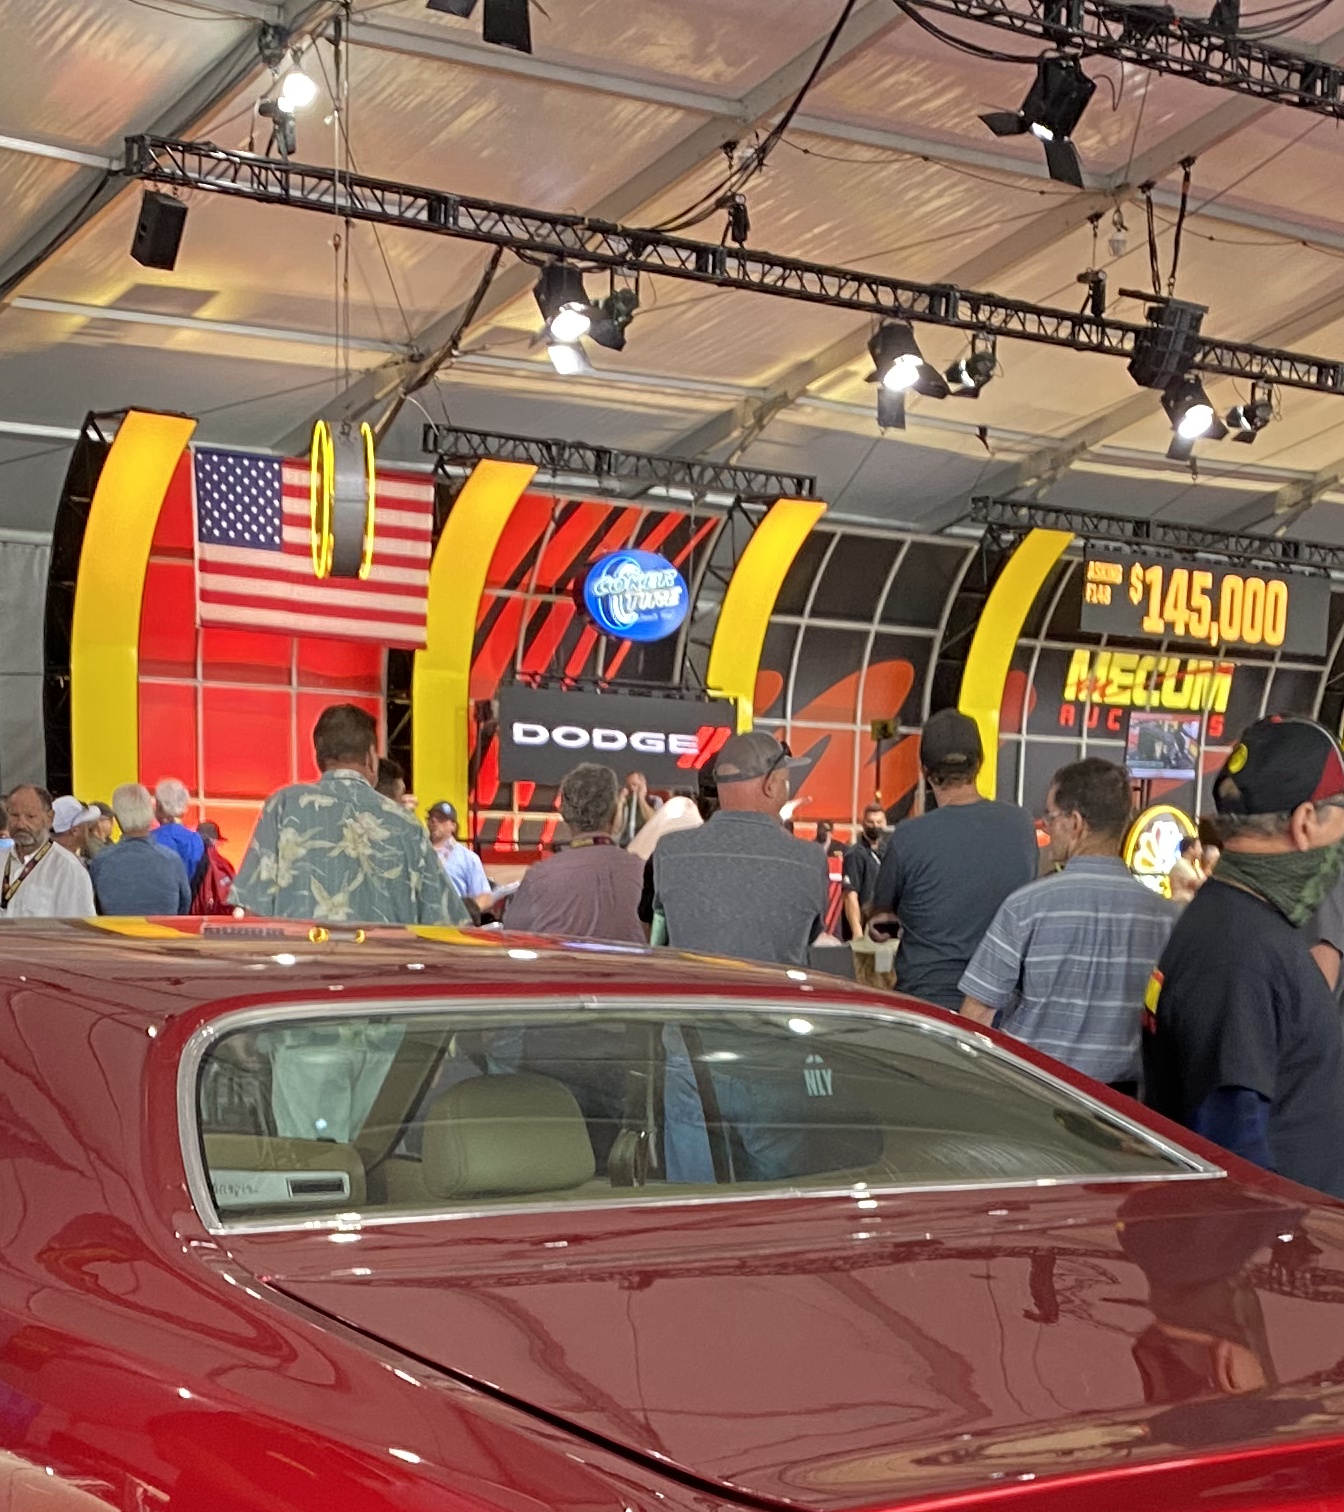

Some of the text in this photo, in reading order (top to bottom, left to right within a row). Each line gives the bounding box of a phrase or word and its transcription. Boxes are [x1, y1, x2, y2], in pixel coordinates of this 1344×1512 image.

[1128, 561, 1288, 647] $145,000
[1063, 648, 1235, 713] MECUM
[512, 722, 700, 755] DODGE
